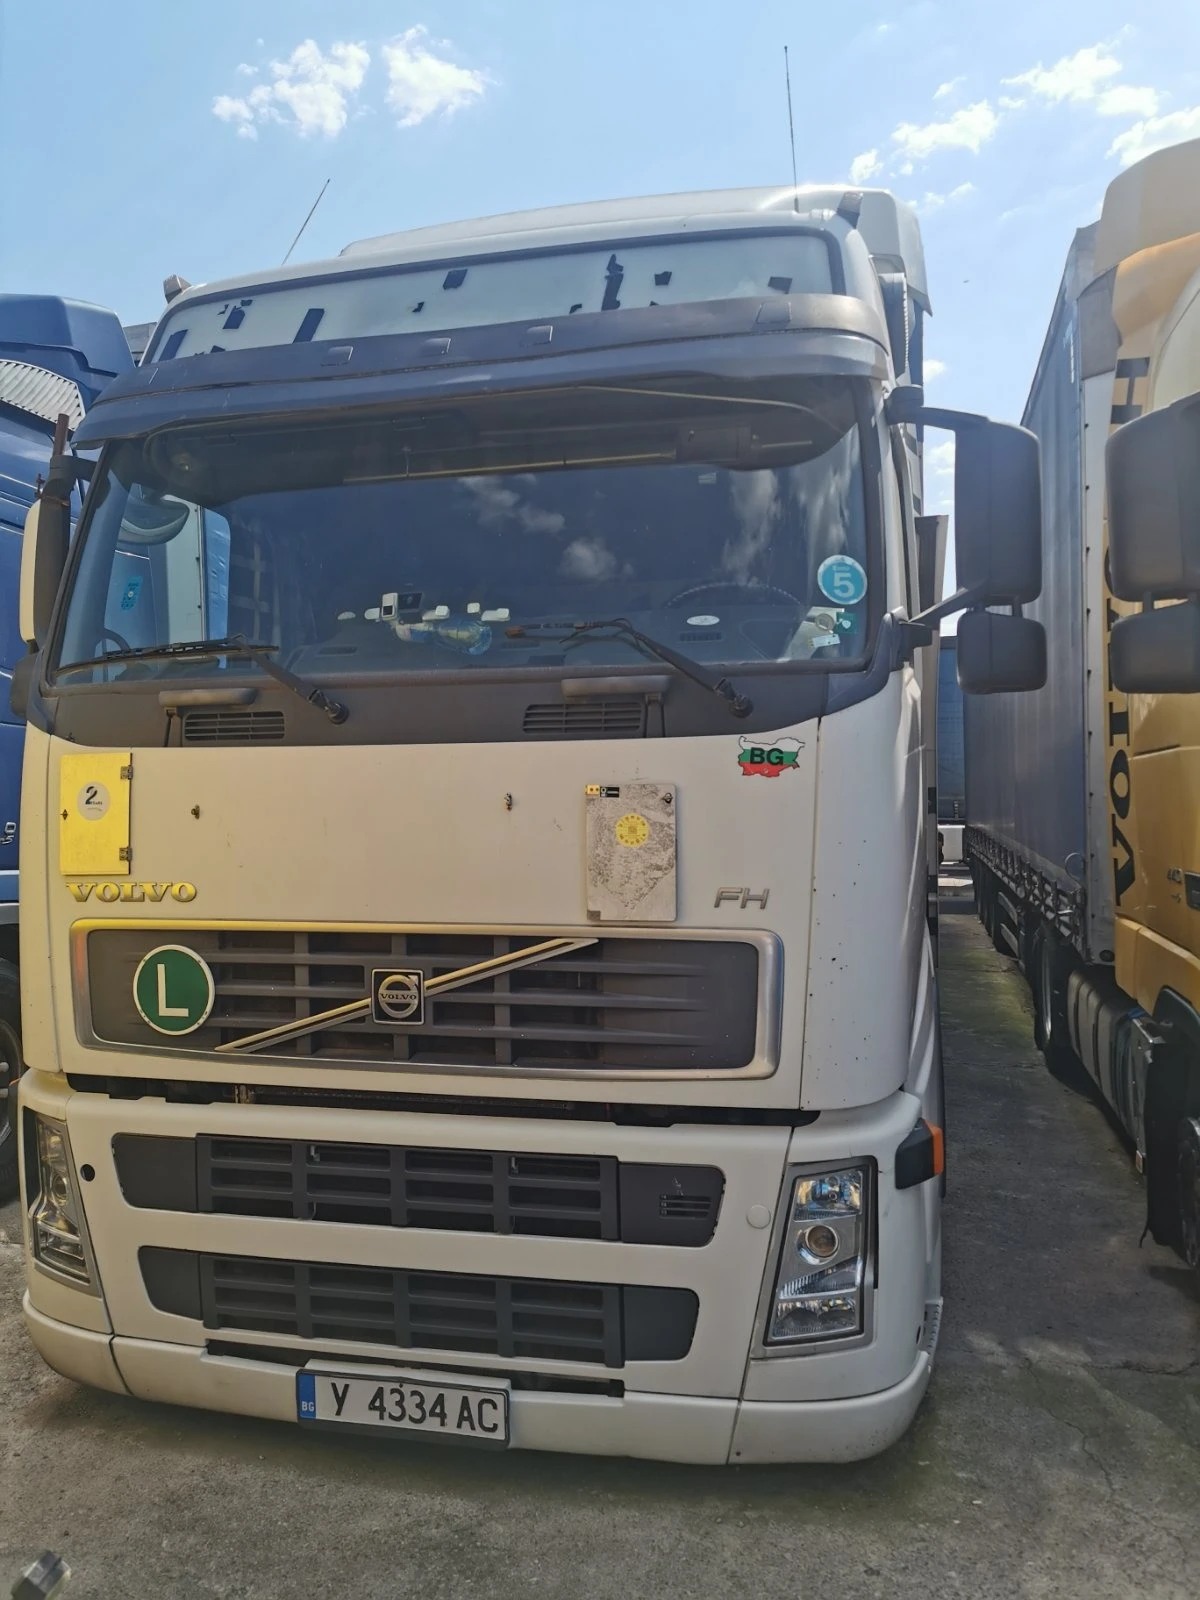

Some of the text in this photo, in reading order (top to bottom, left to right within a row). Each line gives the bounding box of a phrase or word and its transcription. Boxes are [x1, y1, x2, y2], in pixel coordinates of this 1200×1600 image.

[833, 572, 856, 598] 5
[750, 747, 785, 766] BG
[85, 786, 98, 805] 2
[66, 881, 198, 903] VOLVO
[713, 886, 770, 910] FH
[157, 963, 190, 1017] L
[380, 993, 417, 1001] VOLVO
[301, 1400, 315, 1412] BG
[368, 1386, 448, 1427] 4334
[456, 1395, 499, 1433] AC
